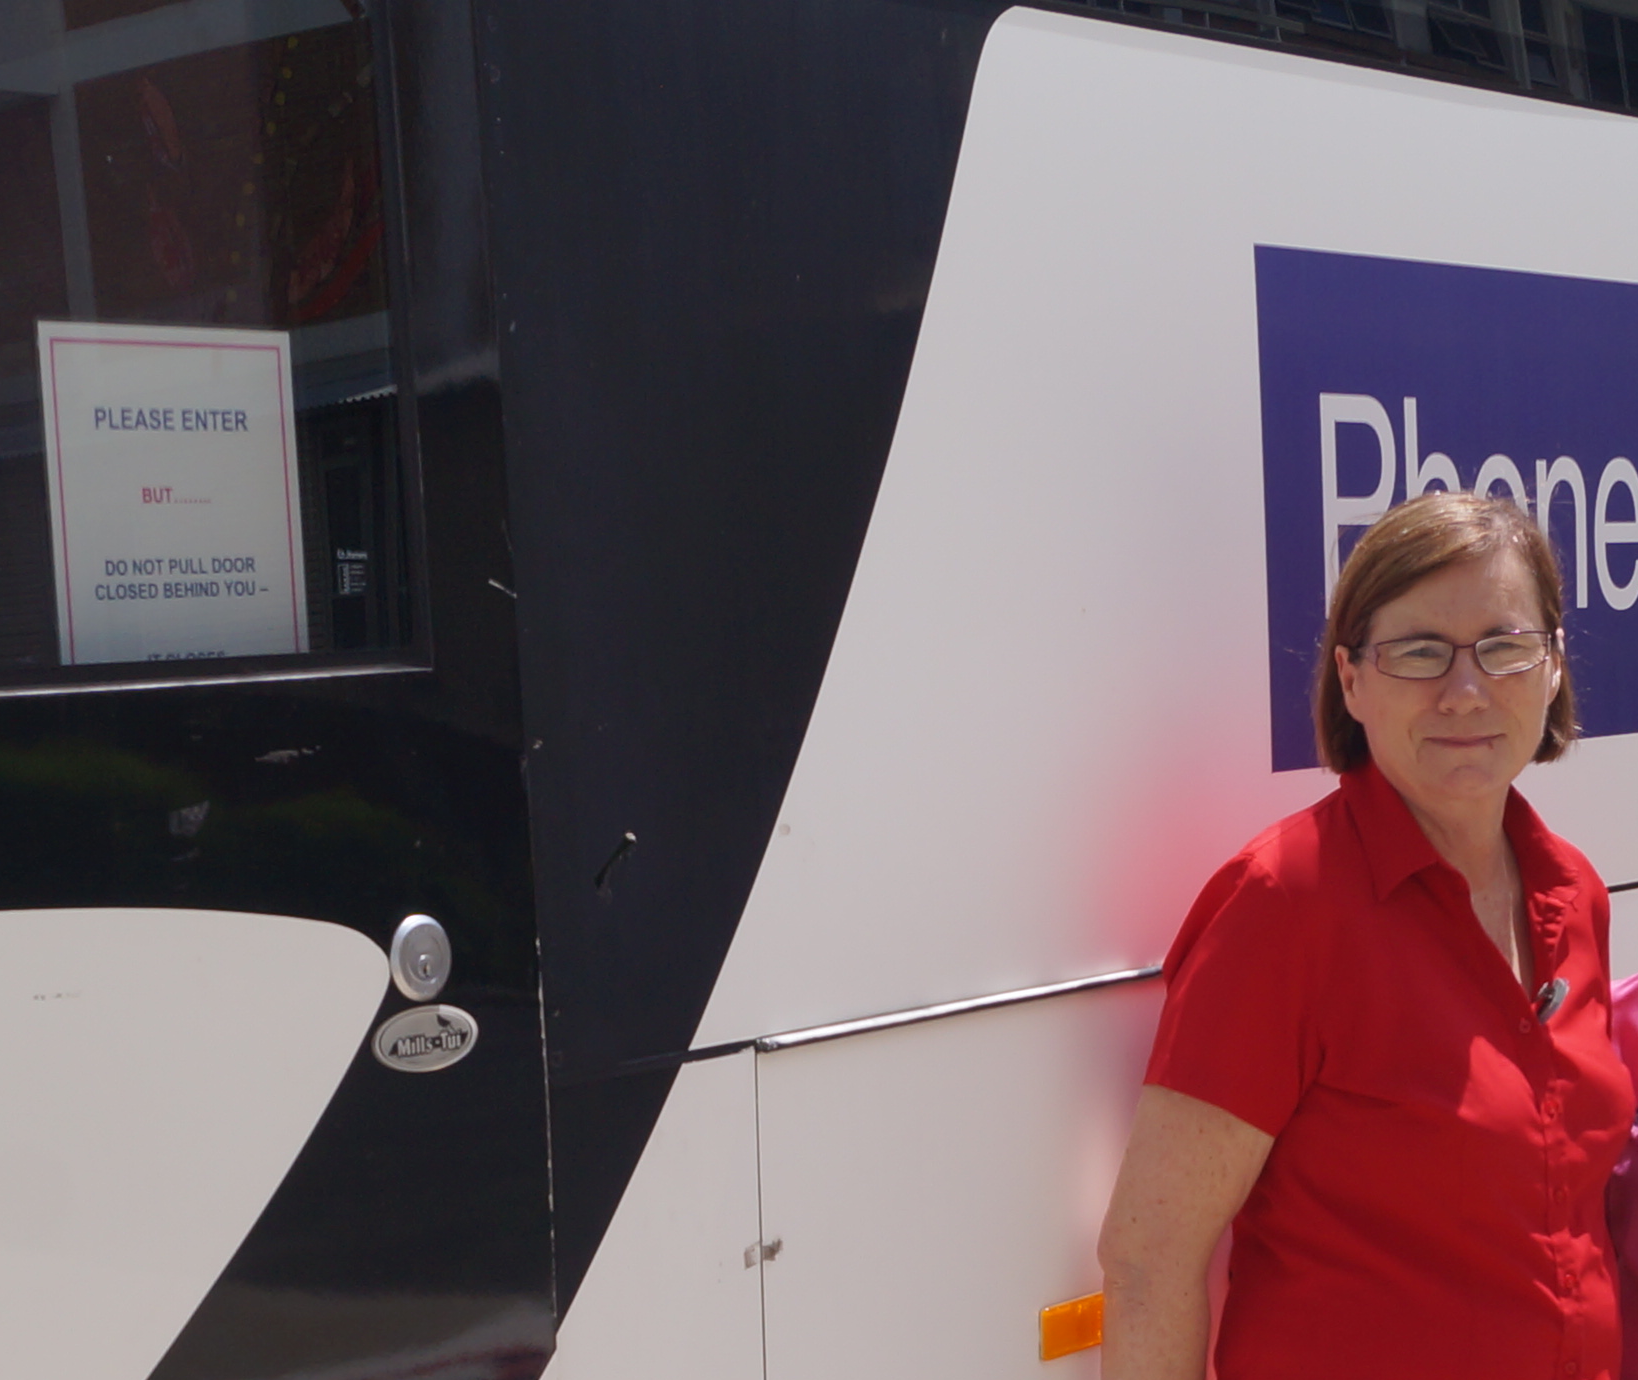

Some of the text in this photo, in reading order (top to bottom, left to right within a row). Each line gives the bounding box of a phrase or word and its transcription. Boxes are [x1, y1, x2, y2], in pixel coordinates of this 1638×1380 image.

[94, 407, 248, 431] PLEASE ENTER
[105, 557, 255, 576] DO NOT PULL DOOR
[95, 583, 158, 600] CLOSED
[163, 582, 220, 598] BEHIND
[226, 580, 256, 596] YOU
